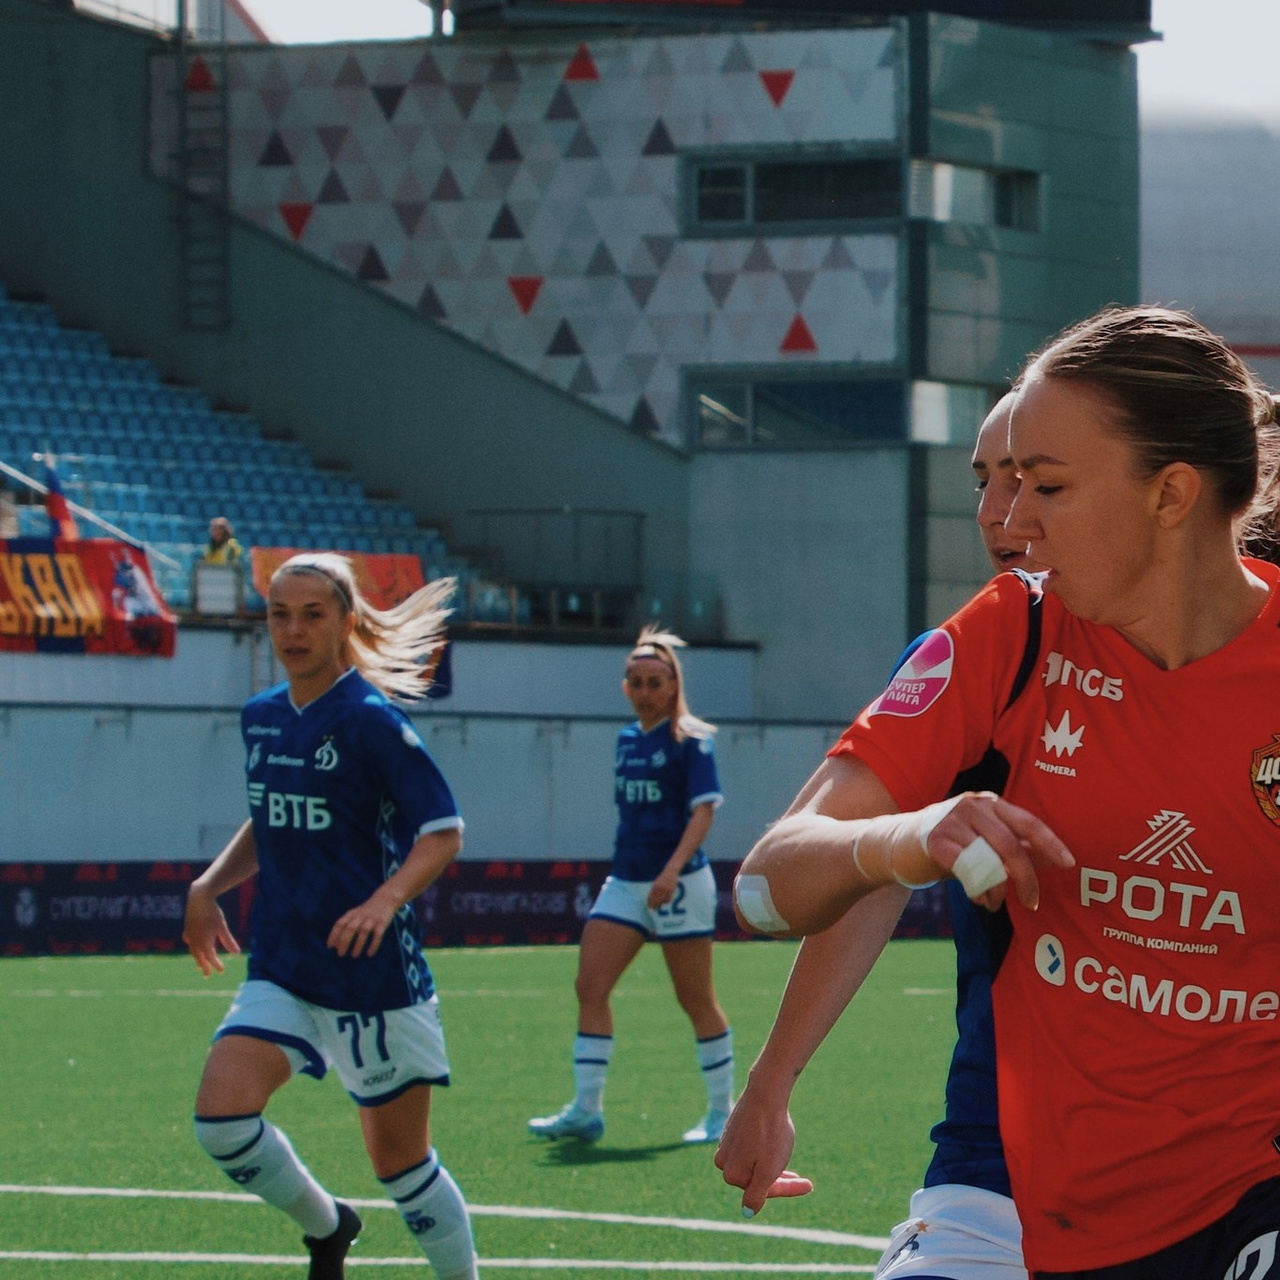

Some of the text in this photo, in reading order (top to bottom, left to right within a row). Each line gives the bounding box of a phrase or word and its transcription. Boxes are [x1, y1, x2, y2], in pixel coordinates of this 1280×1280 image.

[887, 691, 920, 705] ЛИГА
[890, 681, 926, 694] СУПЕР
[1035, 759, 1076, 777] PRIMERA
[626, 780, 662, 803] ВТБ
[268, 792, 331, 830] ВТБ
[1080, 867, 1246, 935] РОТА
[1103, 927, 1218, 955] ГРУППА КОМПАНИЙ
[337, 1010, 390, 1068] 77
